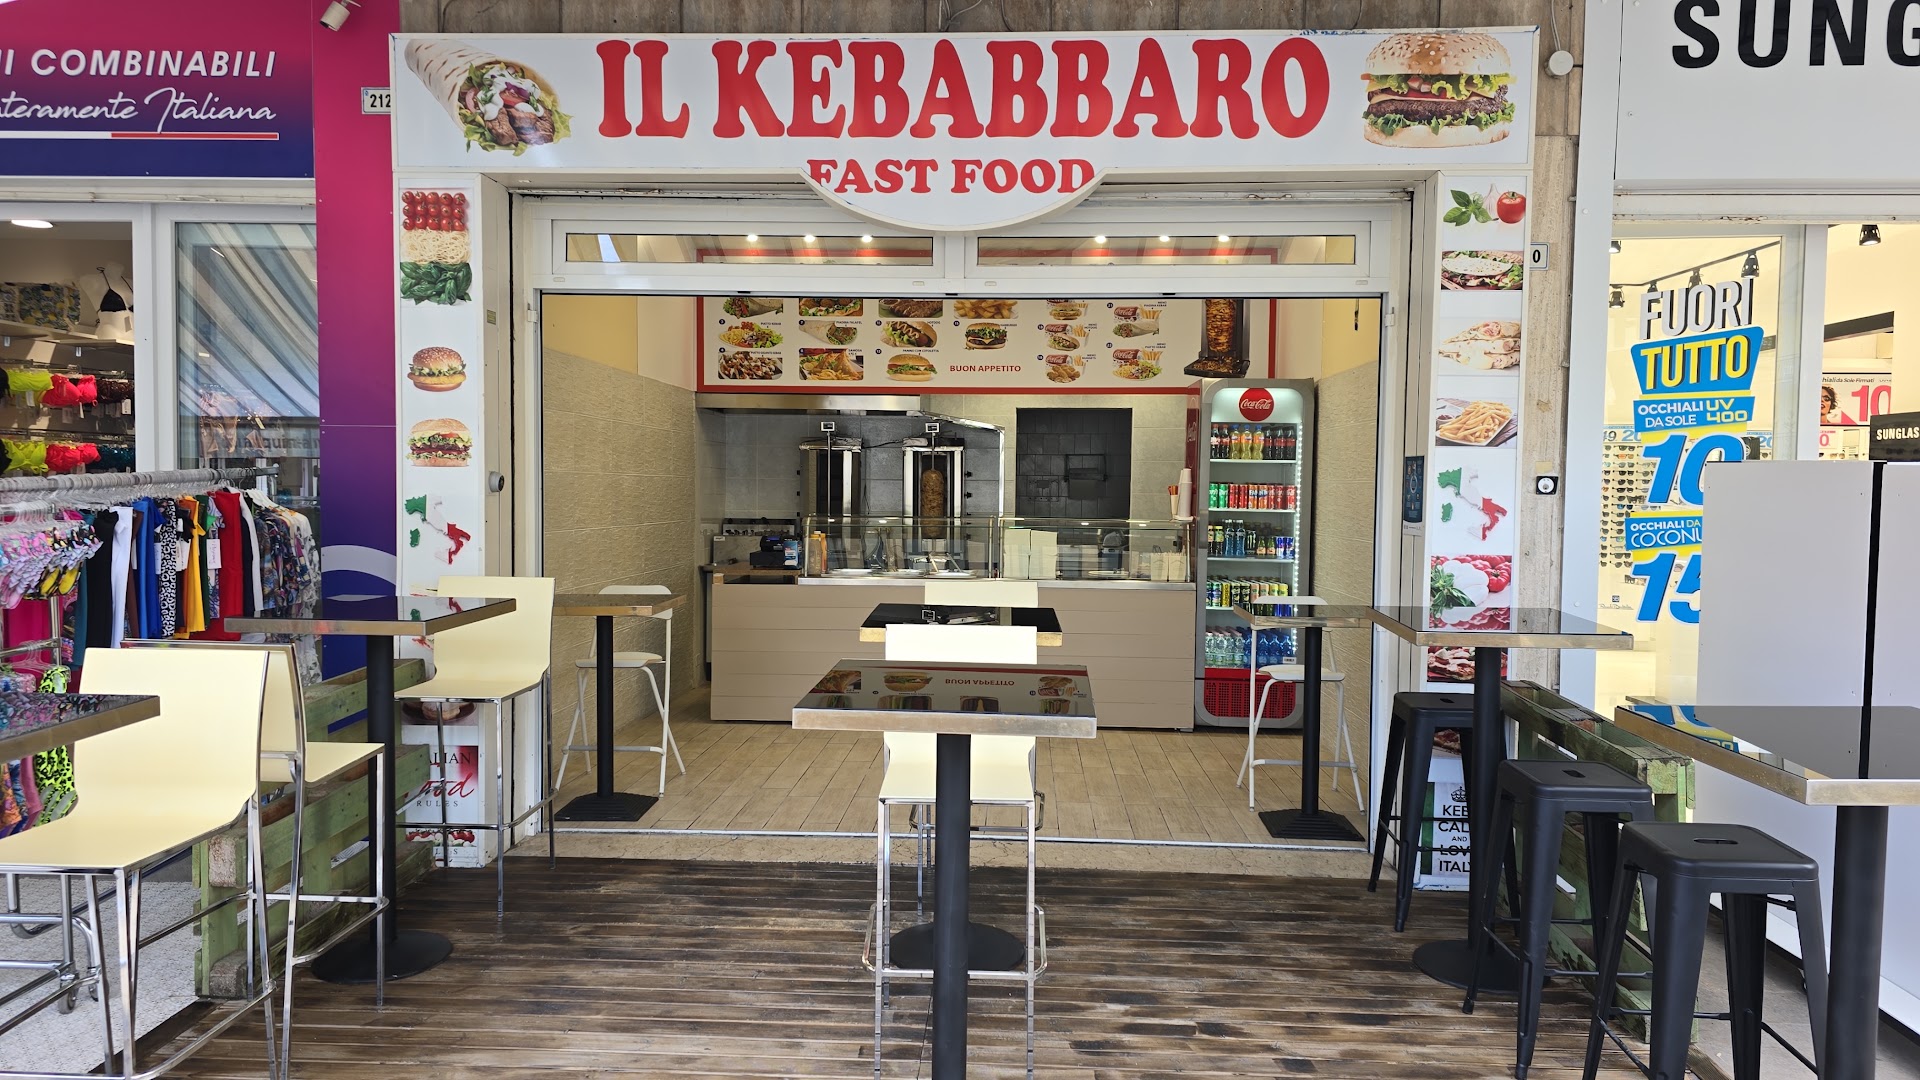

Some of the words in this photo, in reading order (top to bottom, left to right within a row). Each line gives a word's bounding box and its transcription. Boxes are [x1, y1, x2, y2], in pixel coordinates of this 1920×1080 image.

[1672, 0, 1920, 68] SUNG
[0, 49, 15, 76] I
[31, 49, 277, 77] COMBINABILI
[596, 40, 690, 138] IL
[712, 38, 1330, 139] KEBABBARO
[144, 87, 277, 133] Italiana
[369, 93, 391, 108] 212
[807, 158, 939, 194] FAST
[951, 158, 1095, 195] FOOD
[1532, 249, 1541, 263] 0
[1639, 279, 1754, 341] FUORI
[978, 365, 1022, 373] APPETITO
[1640, 335, 1751, 391] TUTTO
[1637, 400, 1704, 416] OCCHIALI
[1706, 398, 1734, 411] UV
[1851, 385, 1891, 421] 10
[1645, 417, 1664, 428] DA
[1665, 414, 1697, 426] SOLE
[1706, 410, 1748, 423] 400
[1876, 427, 1920, 441] SUNGLAS
[1642, 434, 1746, 506] 10
[1630, 520, 1685, 532] OCCHIALI
[1686, 519, 1702, 528] DA
[429, 752, 471, 764] LIAN
[1439, 860, 1471, 873] ITAL
